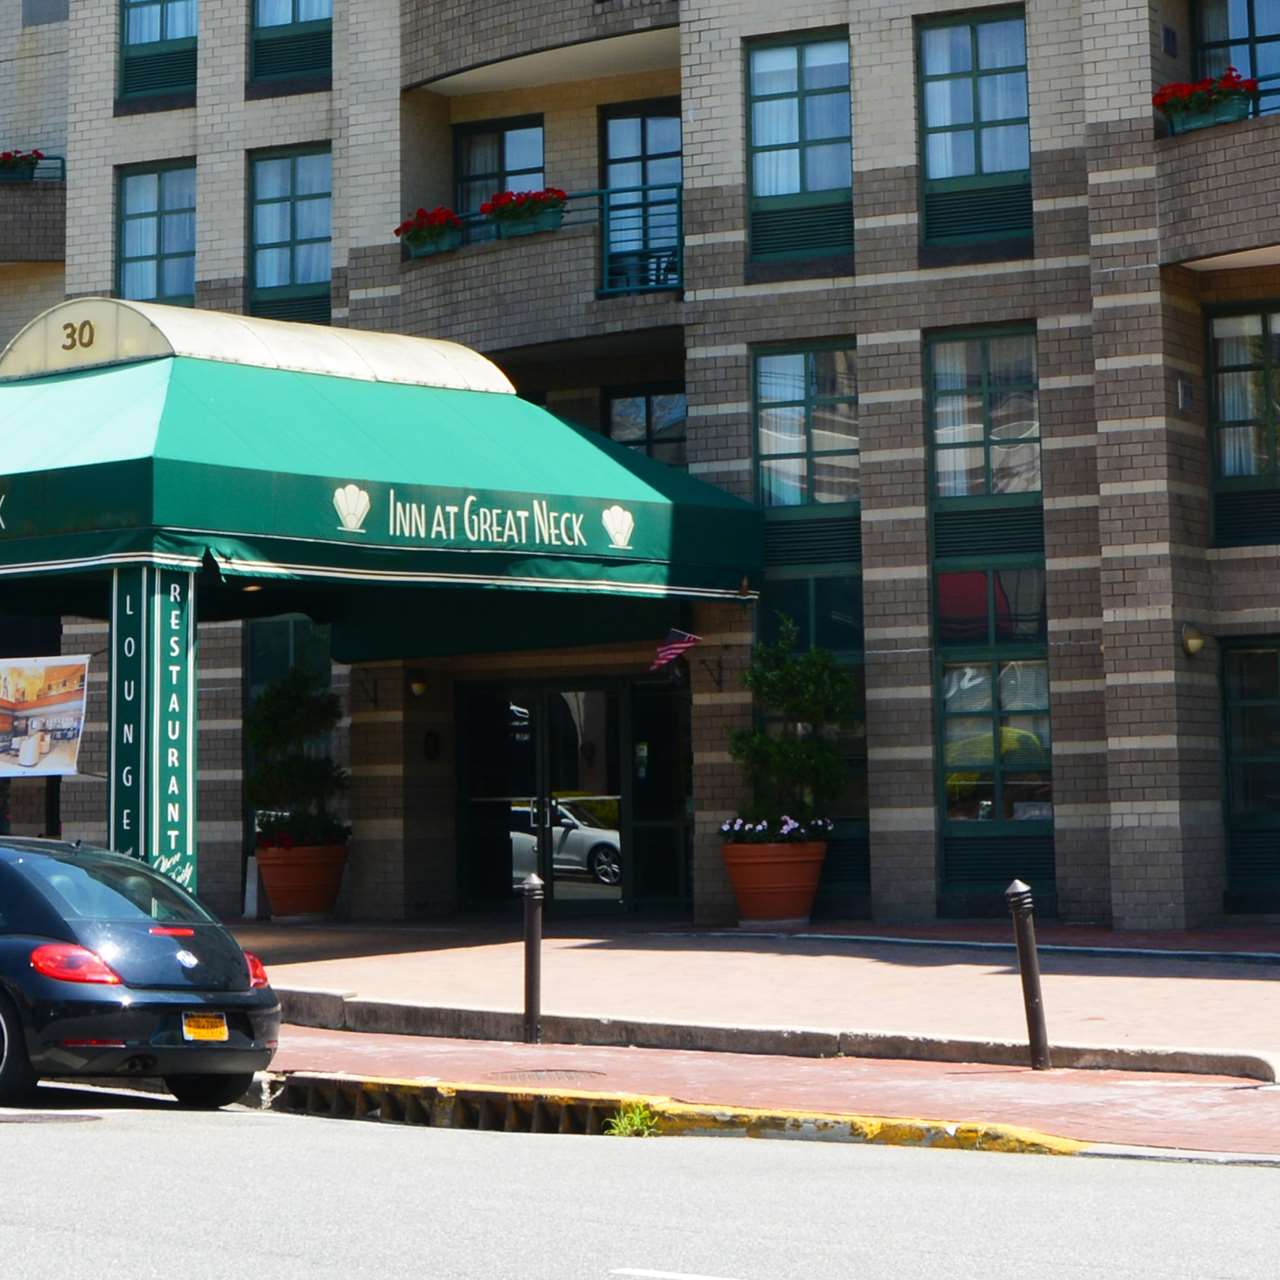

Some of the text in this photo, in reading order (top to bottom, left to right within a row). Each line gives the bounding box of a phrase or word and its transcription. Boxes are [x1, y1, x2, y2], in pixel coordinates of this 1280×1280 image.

[62, 320, 95, 350] 30
[389, 488, 588, 546] INN AT GREAT NECK
[122, 595, 135, 830] LOUNGE
[167, 583, 181, 850] RESTAURANT
